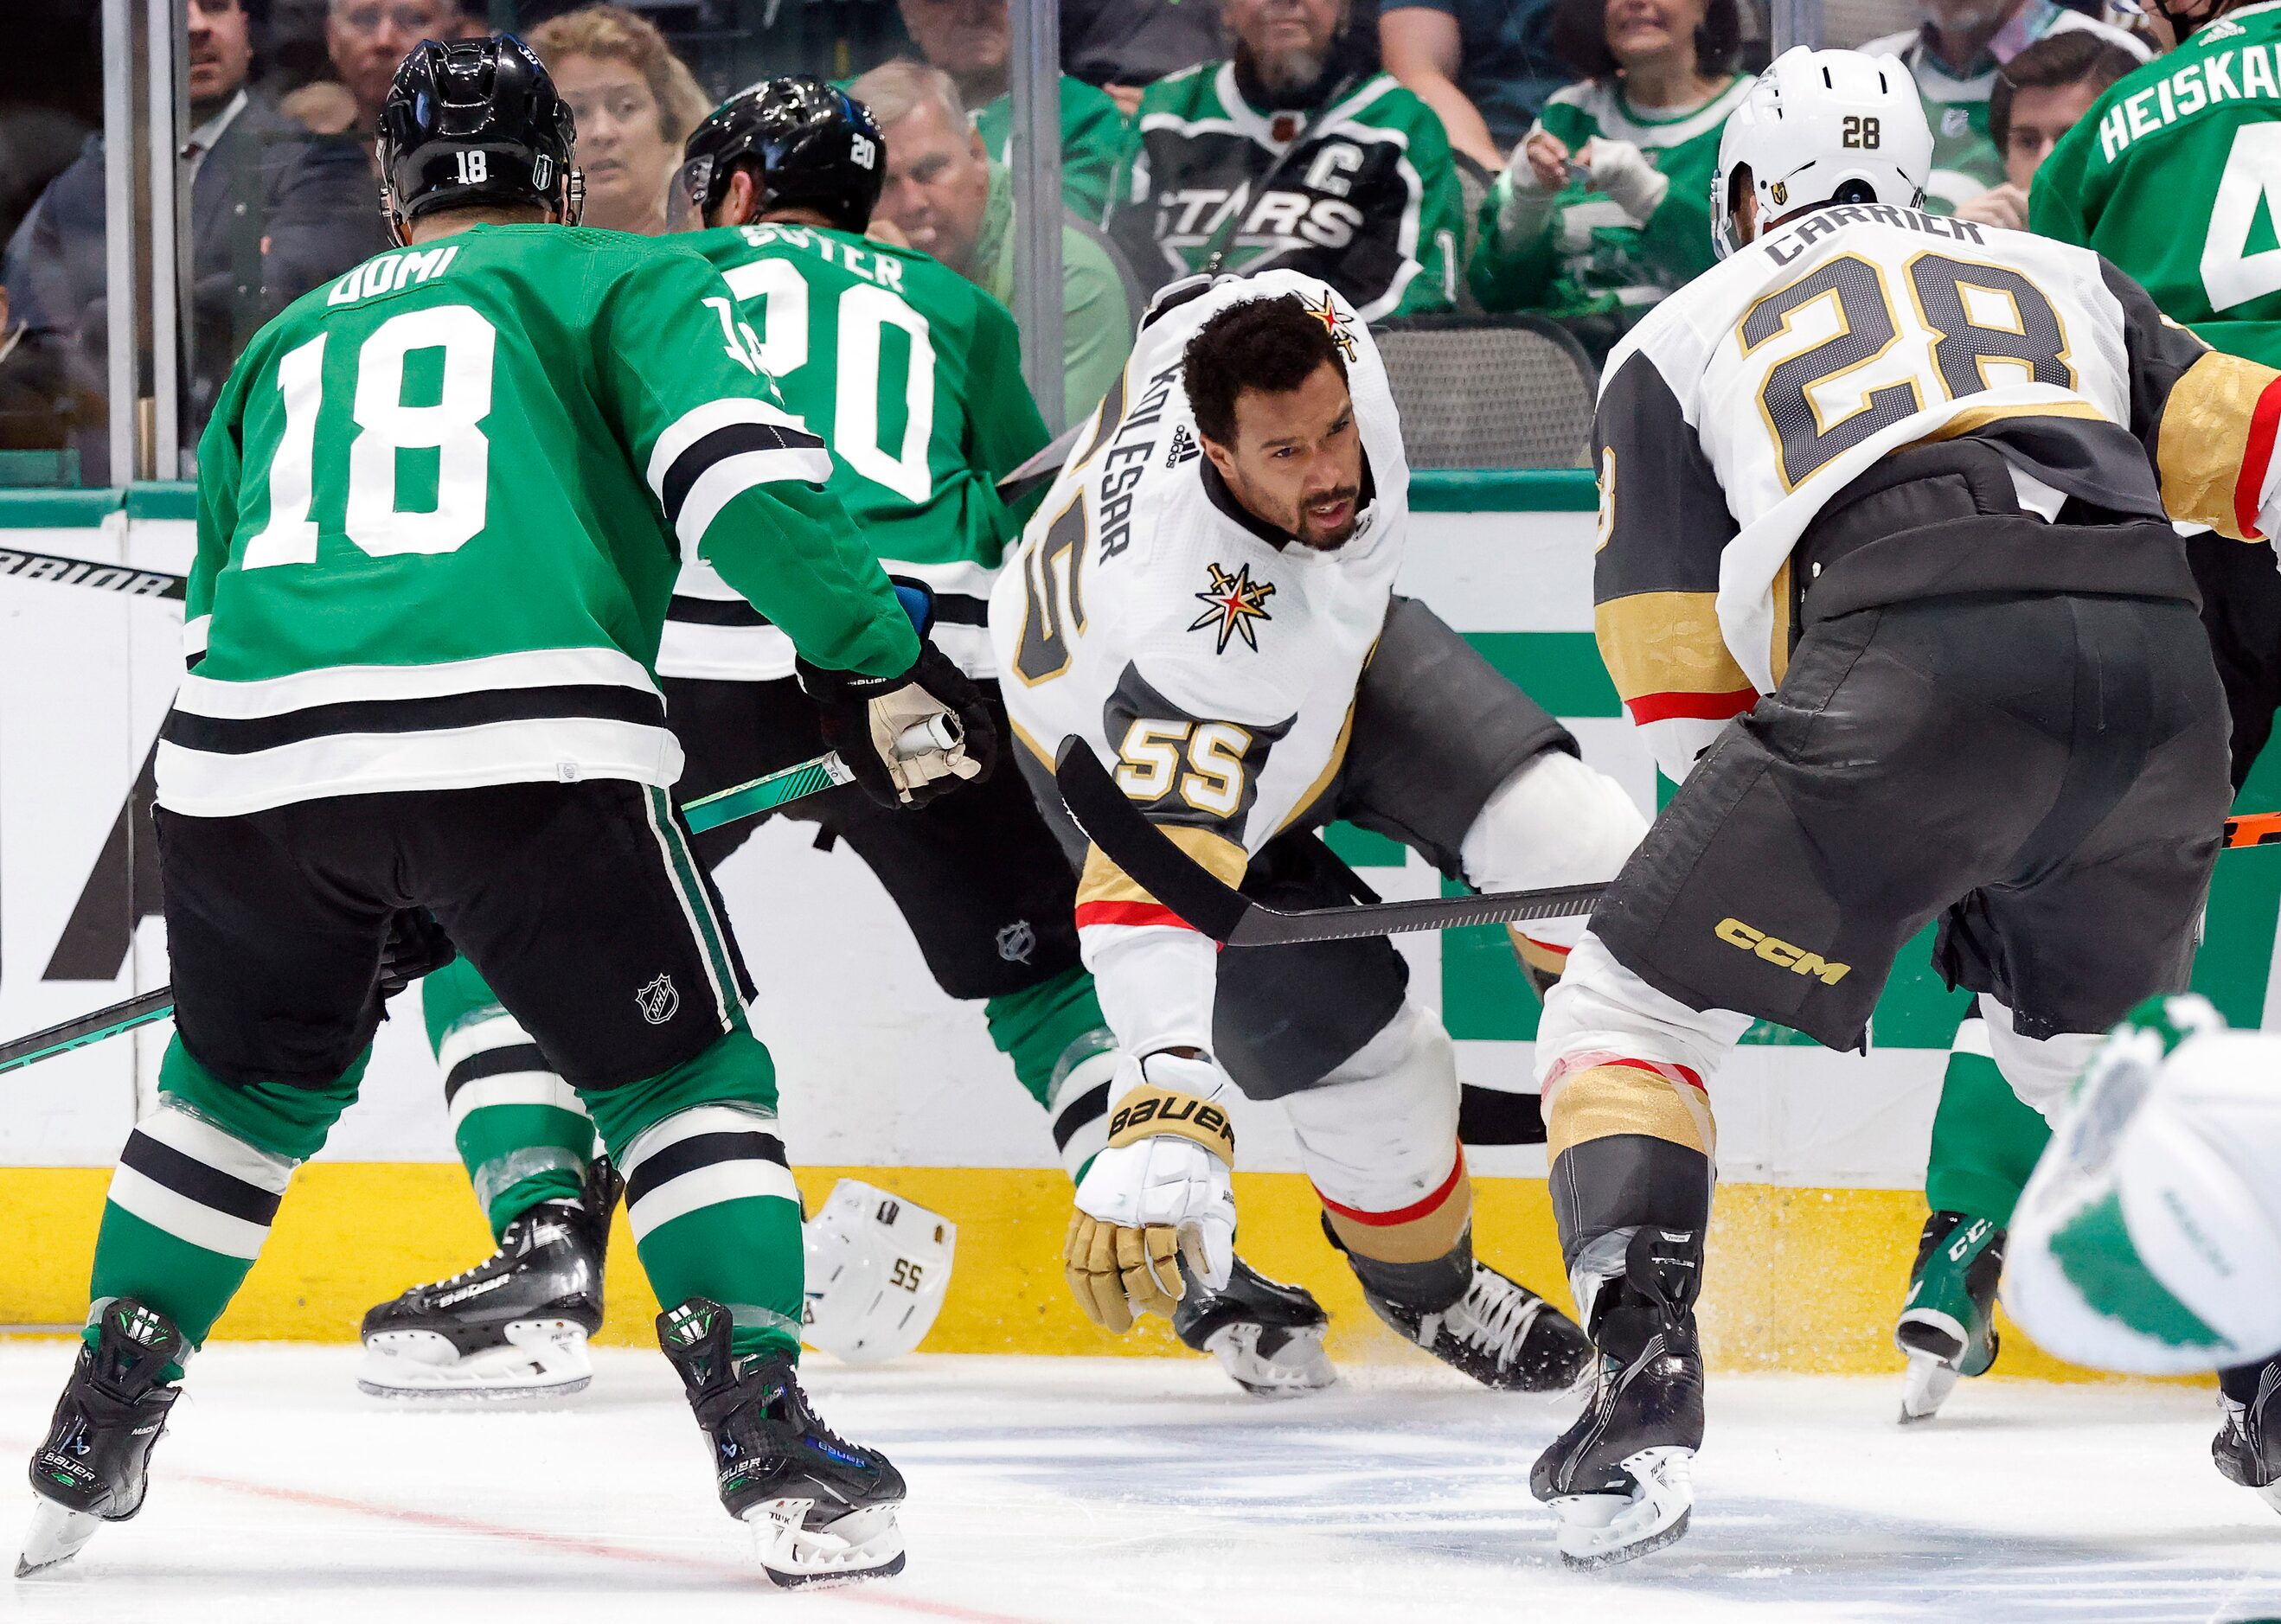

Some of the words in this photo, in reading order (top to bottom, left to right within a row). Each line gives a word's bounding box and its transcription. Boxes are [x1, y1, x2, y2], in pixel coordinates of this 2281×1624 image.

[2099, 43, 2281, 164] HEISKA
[850, 132, 875, 170] 20
[1843, 116, 1881, 150] 28
[455, 150, 489, 185] 18
[1304, 142, 1365, 198] C
[327, 246, 459, 307] DOMI
[1736, 250, 2079, 495] 28
[241, 304, 497, 572] 18
[1166, 425, 1185, 469] adidas
[1099, 360, 1186, 567] KOLESAR
[1115, 717, 1254, 819] 55
[1714, 917, 1853, 986] CCM
[650, 986, 669, 1019] NHL
[1947, 1218, 1993, 1263] CC
[889, 1257, 924, 1294] 55
[44, 1450, 97, 1482] BAUER
